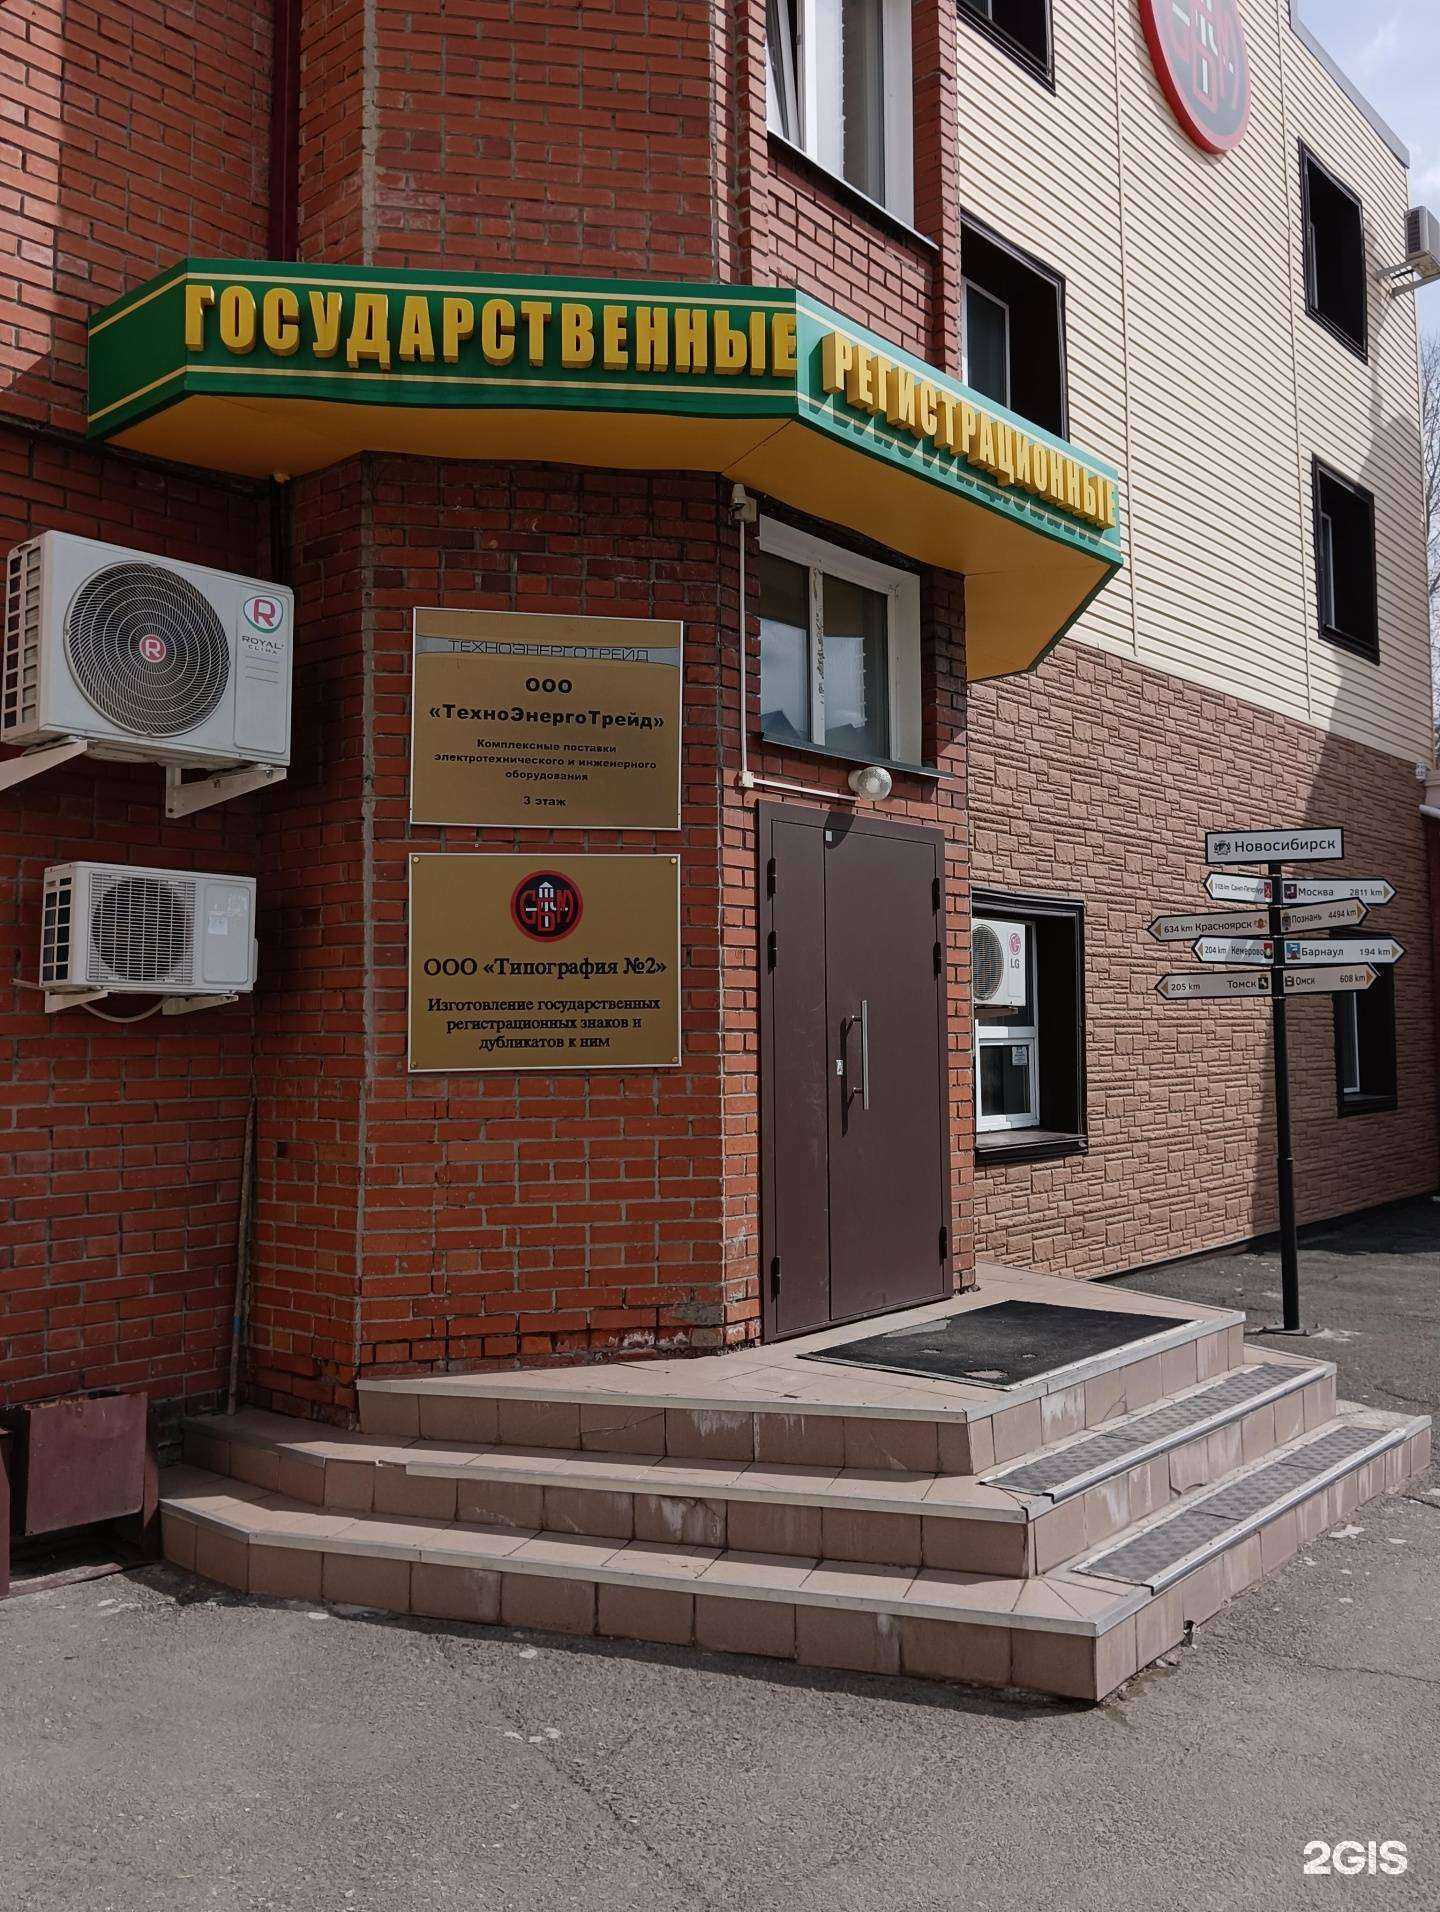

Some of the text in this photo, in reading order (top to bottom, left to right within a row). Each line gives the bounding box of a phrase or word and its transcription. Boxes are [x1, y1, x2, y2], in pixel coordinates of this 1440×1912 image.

[185, 284, 1118, 530] ГОСУДАРСТВЕННЫЕ РЕГИСТРАЦИОННЫЕ
[242, 635, 282, 650] ROYAL
[449, 639, 649, 663] ТЕХНОЭНЕРГОТРЕЙД
[525, 677, 573, 694] ООО
[429, 703, 665, 729] «ТехноЭнергоТрейд»
[477, 738, 617, 754] Комплексные поставки
[434, 752, 657, 771] электротехнического и инженерного
[505, 769, 589, 783] оборудования
[523, 796, 567, 807] 3 этаж
[1234, 838, 1336, 853] Новосибирск
[1298, 888, 1334, 897] Москва
[1349, 888, 1383, 897] 2811 km
[1291, 913, 1322, 924] Познань
[1328, 909, 1357, 920] 4494 km
[1164, 924, 1193, 934] 634 km
[1195, 921, 1253, 933] Красноярск
[1205, 946, 1217, 954] 204
[1301, 947, 1344, 958] Барнаул
[1360, 947, 1391, 956] 194 km
[423, 956, 667, 980] ООО «Типография №2»
[1010, 957, 1020, 969] LG
[1227, 979, 1257, 989] Томск
[1295, 976, 1316, 986] Омск
[1339, 973, 1366, 983] 608 km
[1171, 981, 1201, 992] 205 km
[427, 998, 661, 1014] Изготовление государственных
[446, 1017, 642, 1034] регистрационных знаков и
[479, 1036, 611, 1050] дубликатов к ним
